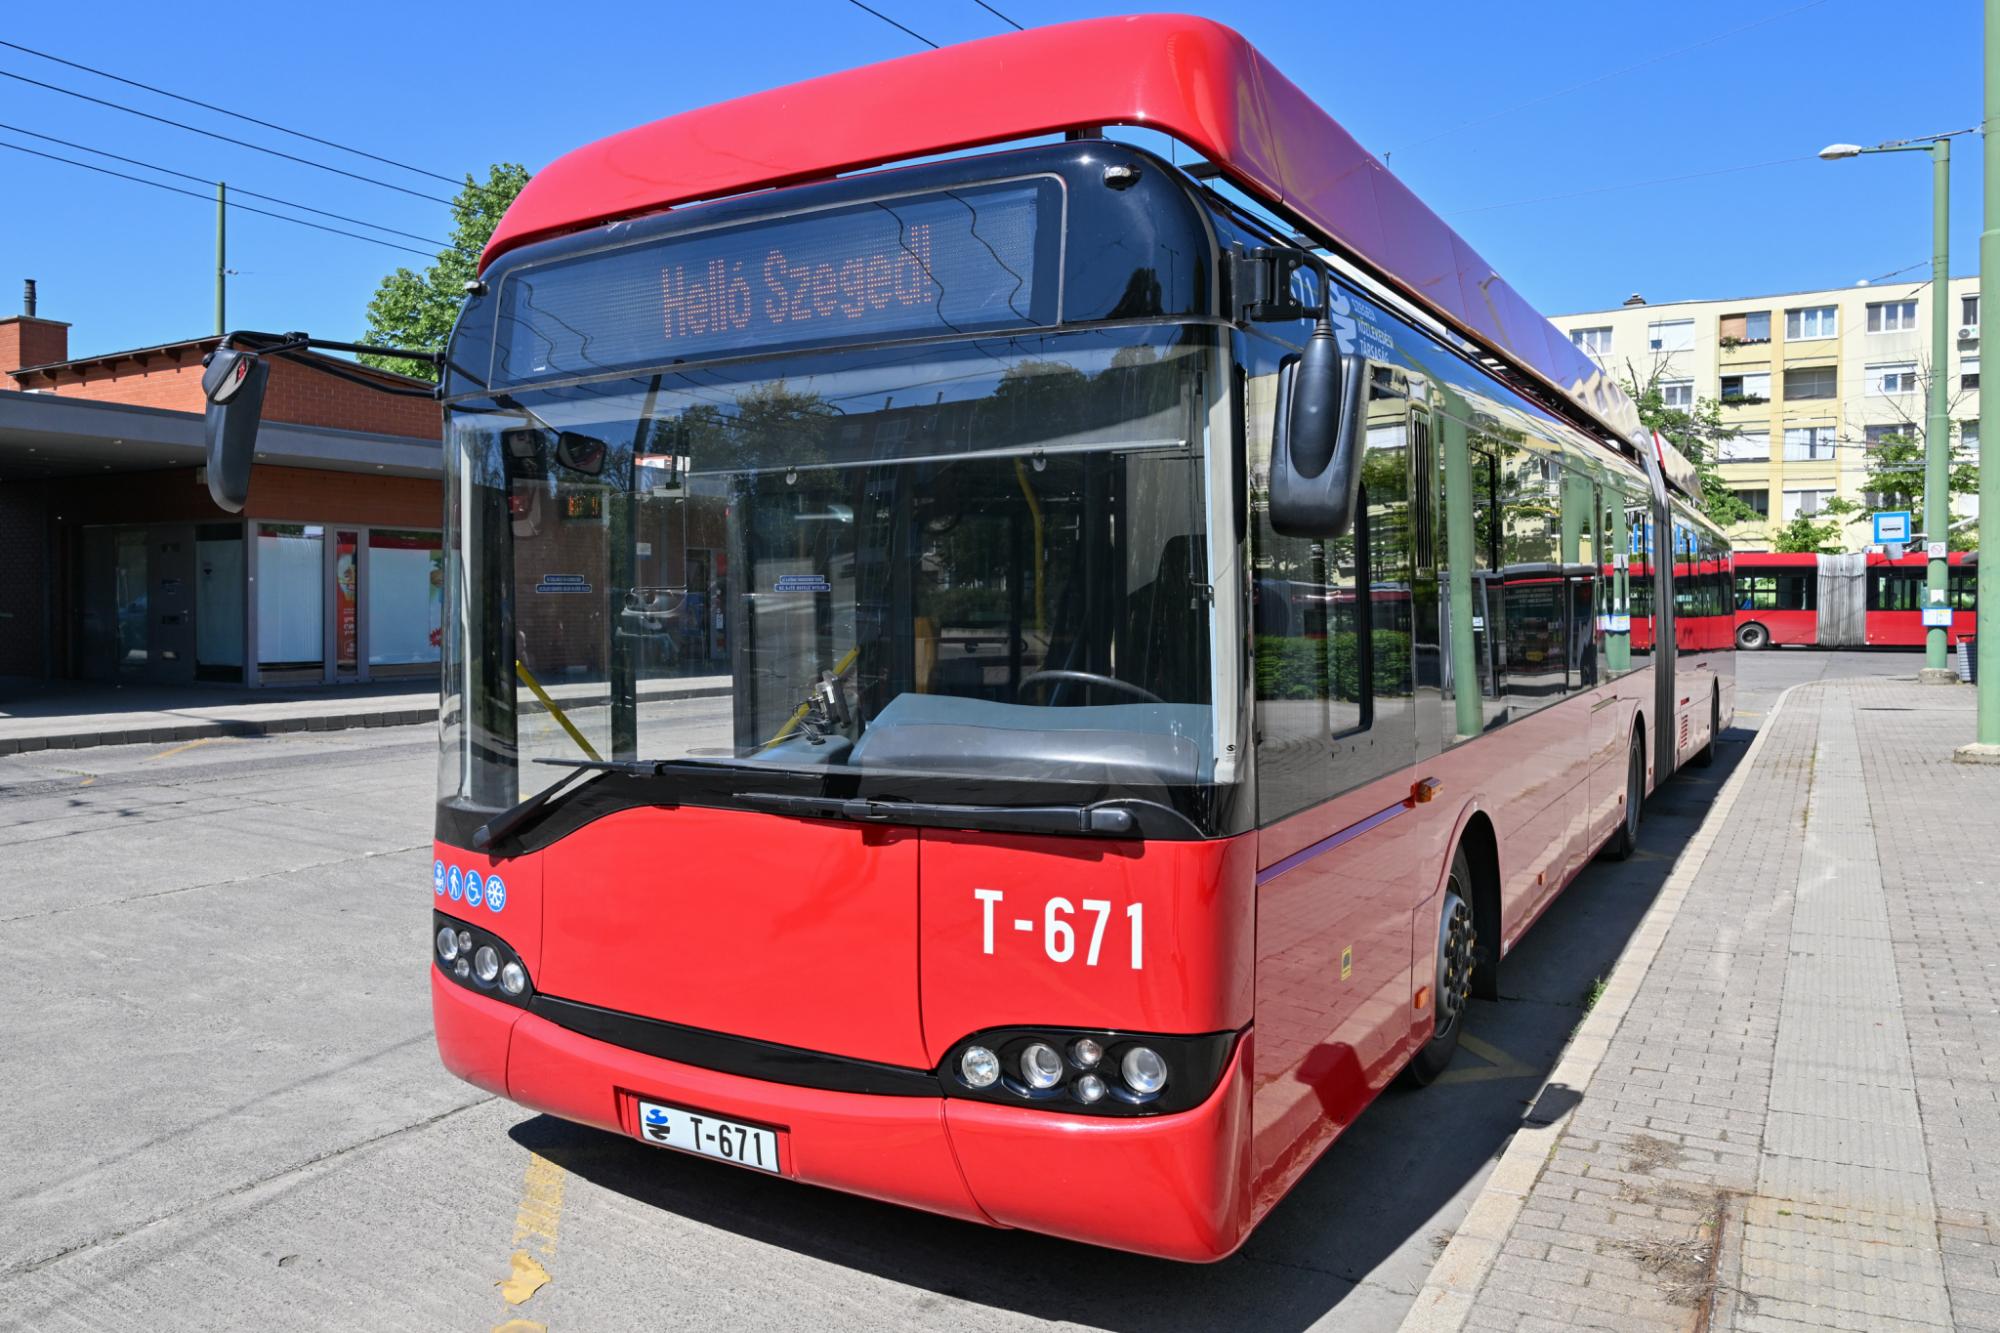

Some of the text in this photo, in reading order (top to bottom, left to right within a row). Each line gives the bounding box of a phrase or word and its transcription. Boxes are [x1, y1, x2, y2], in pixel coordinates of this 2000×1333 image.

[662, 224, 932, 340] Helló Szeged!
[974, 888, 1143, 970] T-671
[689, 1116, 763, 1166] T-671
